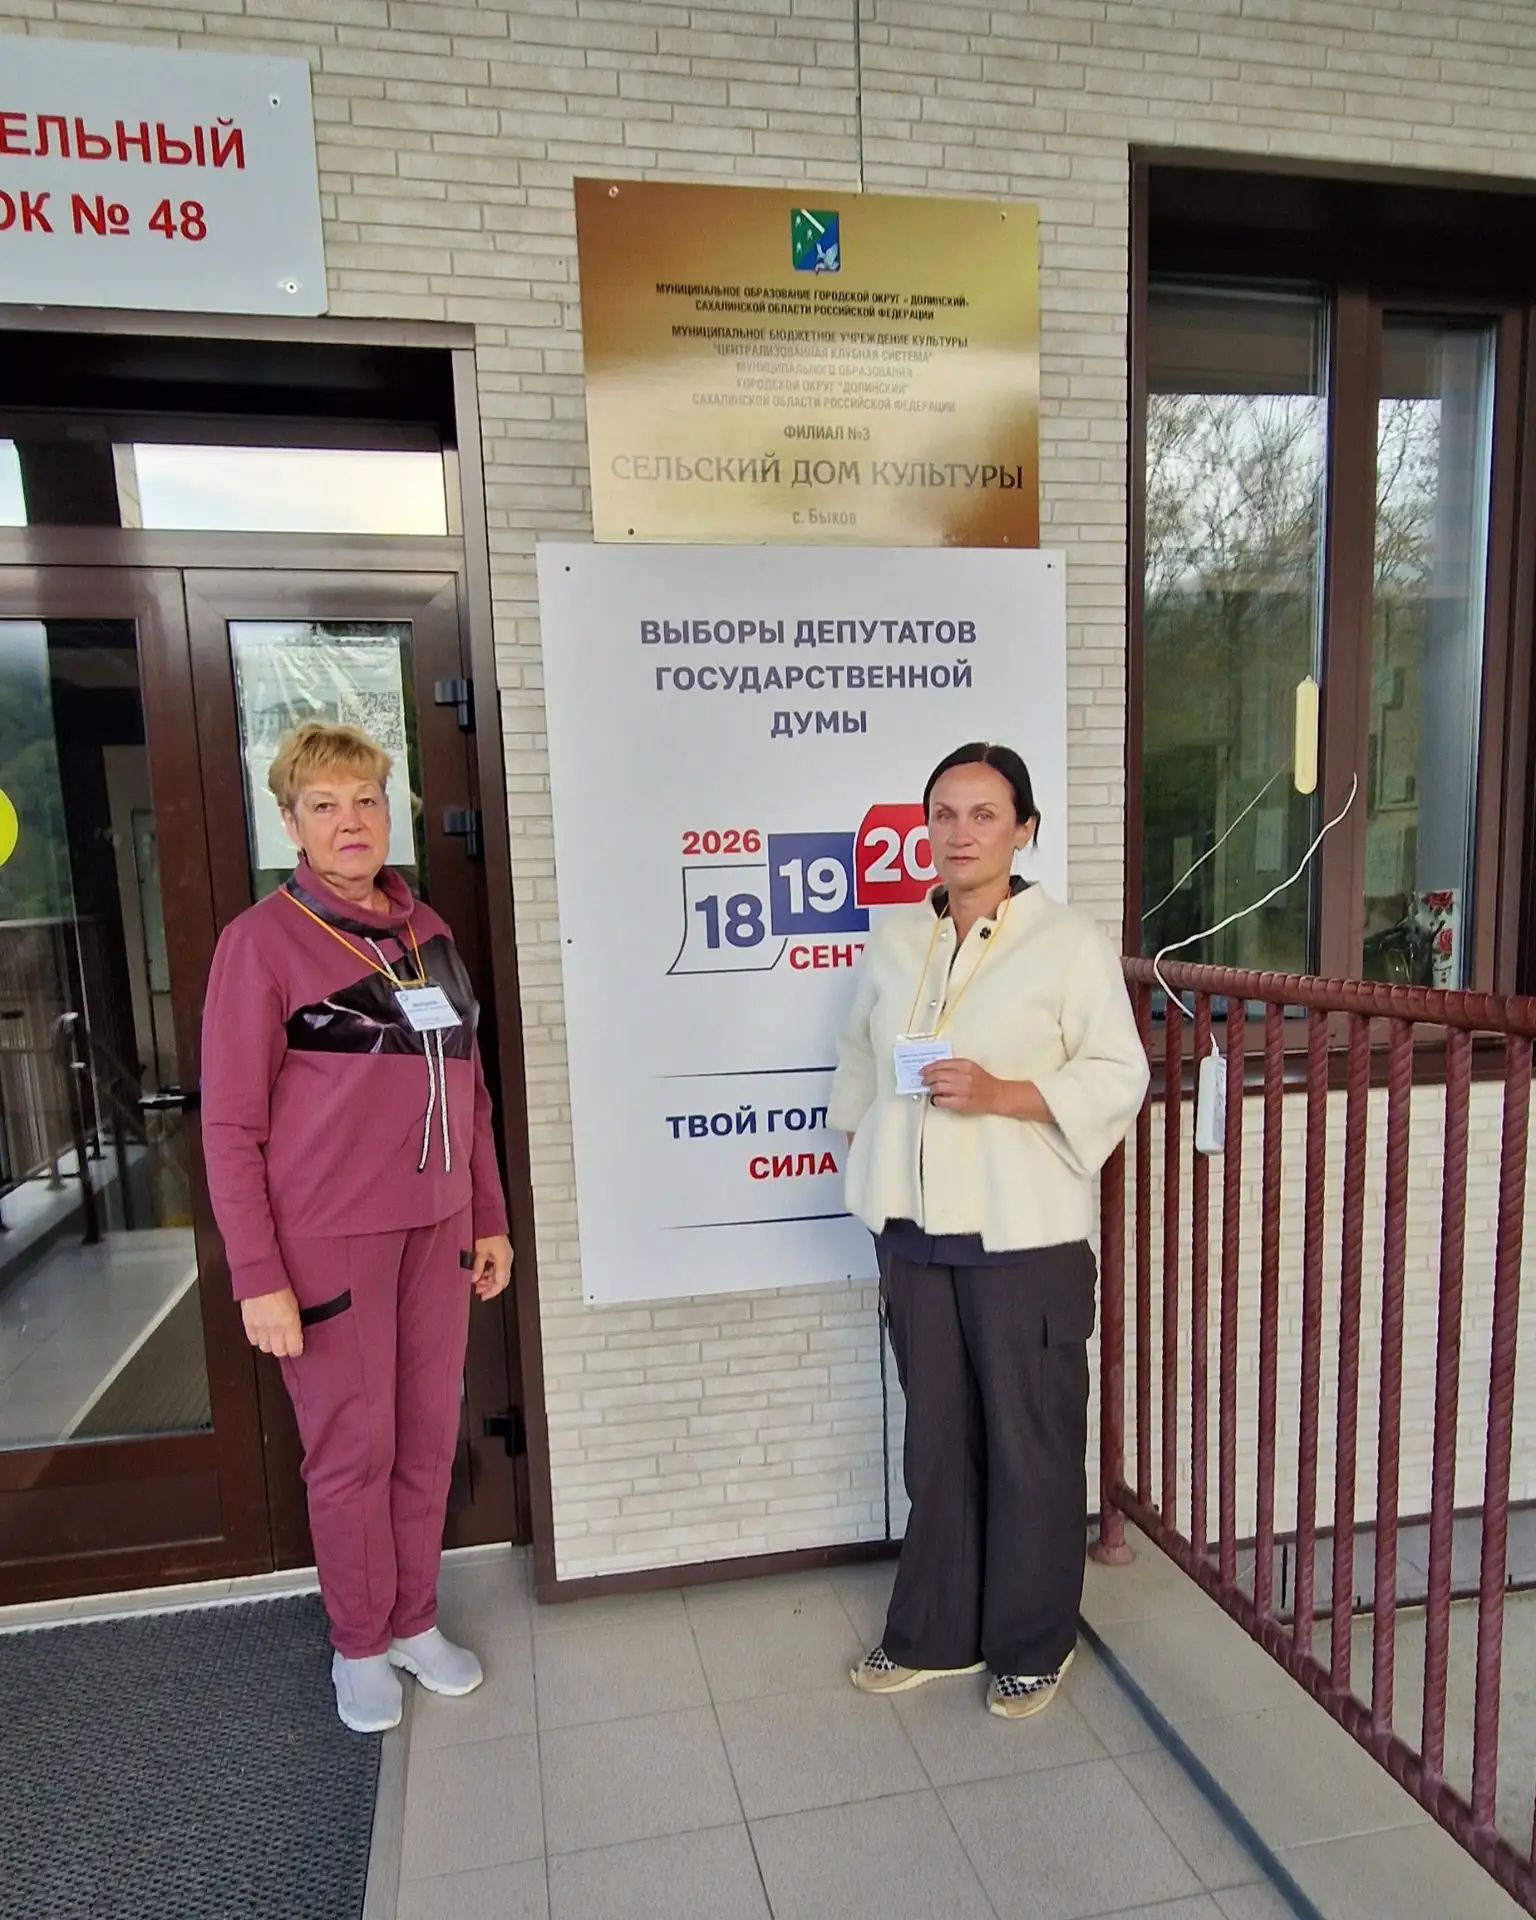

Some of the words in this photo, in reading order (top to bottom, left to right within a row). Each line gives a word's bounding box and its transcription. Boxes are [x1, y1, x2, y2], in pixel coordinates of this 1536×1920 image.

[0, 111, 245, 169] ЕЛЬНЫЙ
[71, 194, 130, 236] №
[149, 199, 207, 241] 48
[656, 282, 740, 297] МУНИЦИПАЛЬНОЕ
[744, 286, 810, 300] ОБРАЗОВАНИЕ
[814, 288, 870, 303] ГОРОДСКОЙ
[872, 292, 900, 304] ОКРУГ
[696, 299, 766, 313] САХАЛИНСКОЙ
[768, 302, 811, 315] ОБЛАСТИ
[814, 304, 875, 318] РОССИЙСКОЙ
[878, 308, 935, 321] ФЕДЕРАЦИИ
[672, 325, 765, 340] МУНИЦИПАЛЬНОЕ
[769, 328, 835, 342] БЮДЖЕТНОЕ
[840, 332, 909, 345] УЧРЕЖДЕНИЕ
[912, 335, 968, 348] КУЛЬТУРЫ
[802, 380, 834, 392] ОКРУГ
[692, 393, 770, 407] САХАЛИНСКОЙ
[773, 395, 820, 409] ОБЛАСТИ
[823, 396, 891, 411] РОССИЙСКОЙ
[894, 399, 956, 413] ФЕДЕРАЦИИ
[784, 425, 844, 440] ФИЛИАЛ
[847, 426, 870, 441] №3
[611, 450, 781, 483] СЕЛЬСКИЙ
[791, 458, 861, 489] ДОМ
[872, 460, 1024, 490] КУЛЬТУРЫ
[808, 508, 857, 526] Быков
[640, 620, 785, 645] ВЫБОРЫ
[794, 620, 977, 648] ДЕПУТАТОВ
[655, 658, 973, 694] ГОСУДАРСТВЕННОЙ
[770, 710, 868, 738] ДУМЫ
[682, 829, 761, 855] 2026
[695, 893, 765, 949] 18
[779, 857, 848, 915] 19
[864, 826, 939, 883] 20
[666, 1105, 757, 1139] ТВОЙ
[768, 1106, 828, 1132] ГОЛ
[749, 1151, 839, 1180] СИЛА
